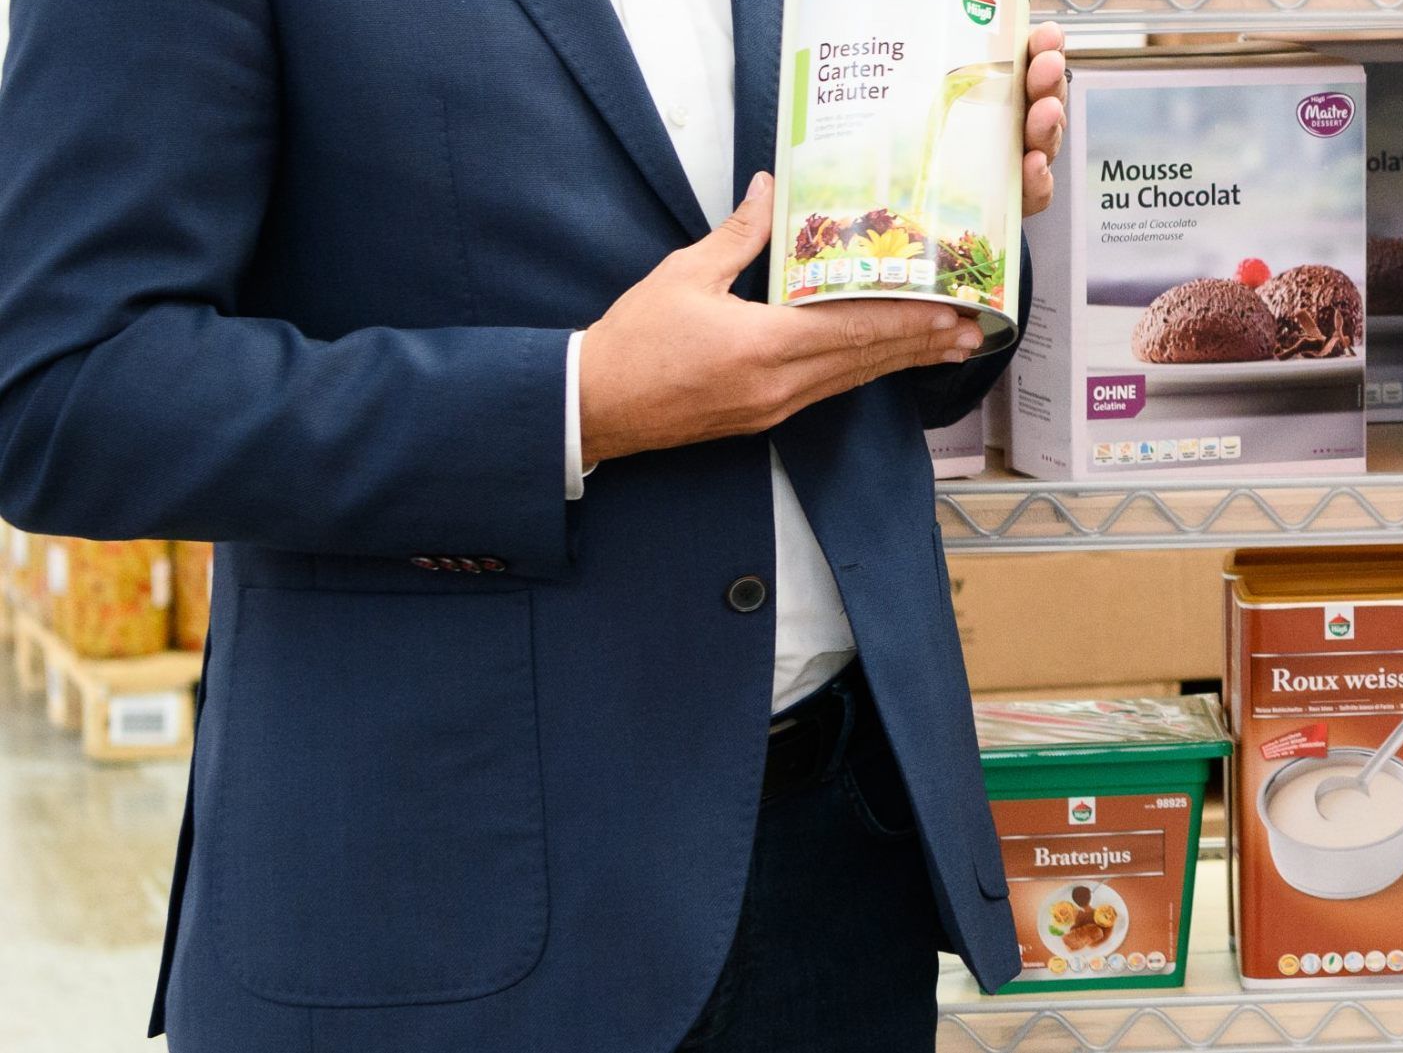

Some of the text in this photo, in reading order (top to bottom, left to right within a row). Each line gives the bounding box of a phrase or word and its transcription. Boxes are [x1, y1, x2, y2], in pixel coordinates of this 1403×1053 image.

[819, 36, 905, 61] Dressing
[818, 60, 894, 82] Garten-
[817, 82, 889, 105] kräuter
[1311, 119, 1343, 128] DESSERT
[1101, 159, 1193, 182] Mousse
[1101, 183, 1241, 210] au Chocolat
[1101, 218, 1198, 231] Mousse al Cioccolato
[1101, 232, 1184, 244] Chocolademousse
[1093, 384, 1137, 401] OHNE
[1093, 402, 1127, 412] Gelatine
[1271, 668, 1340, 692] Roux
[1156, 797, 1188, 809] 98925
[1033, 846, 1131, 871] Bratenjus
